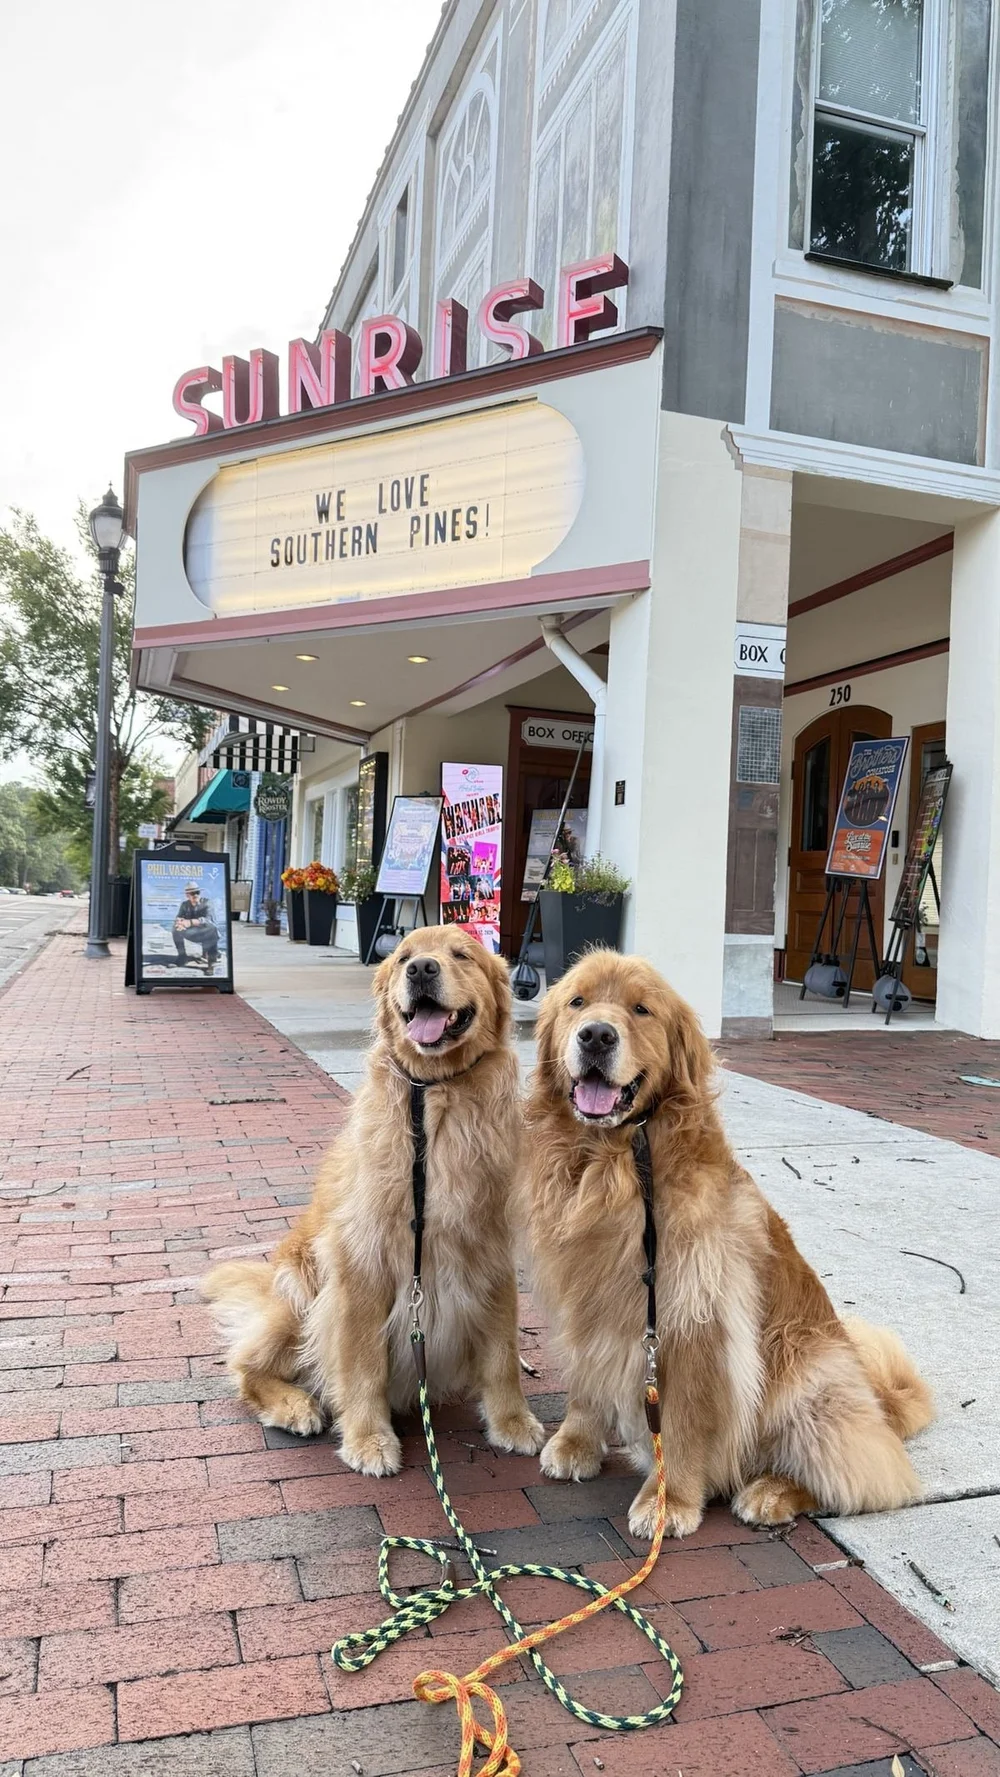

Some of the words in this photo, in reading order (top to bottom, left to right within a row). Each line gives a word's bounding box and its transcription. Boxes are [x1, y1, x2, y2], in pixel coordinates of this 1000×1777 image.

[172, 253, 629, 436] SUNRISE
[316, 489, 346, 524] WE
[378, 473, 429, 514] LOVE
[270, 522, 378, 567] SOUTHERN
[410, 503, 490, 548] PINES!
[740, 643, 768, 663] BOX
[829, 684, 851, 706] 250
[528, 726, 555, 739] BOX
[147, 863, 167, 876] PHIL
[169, 864, 203, 877] VASSAR
